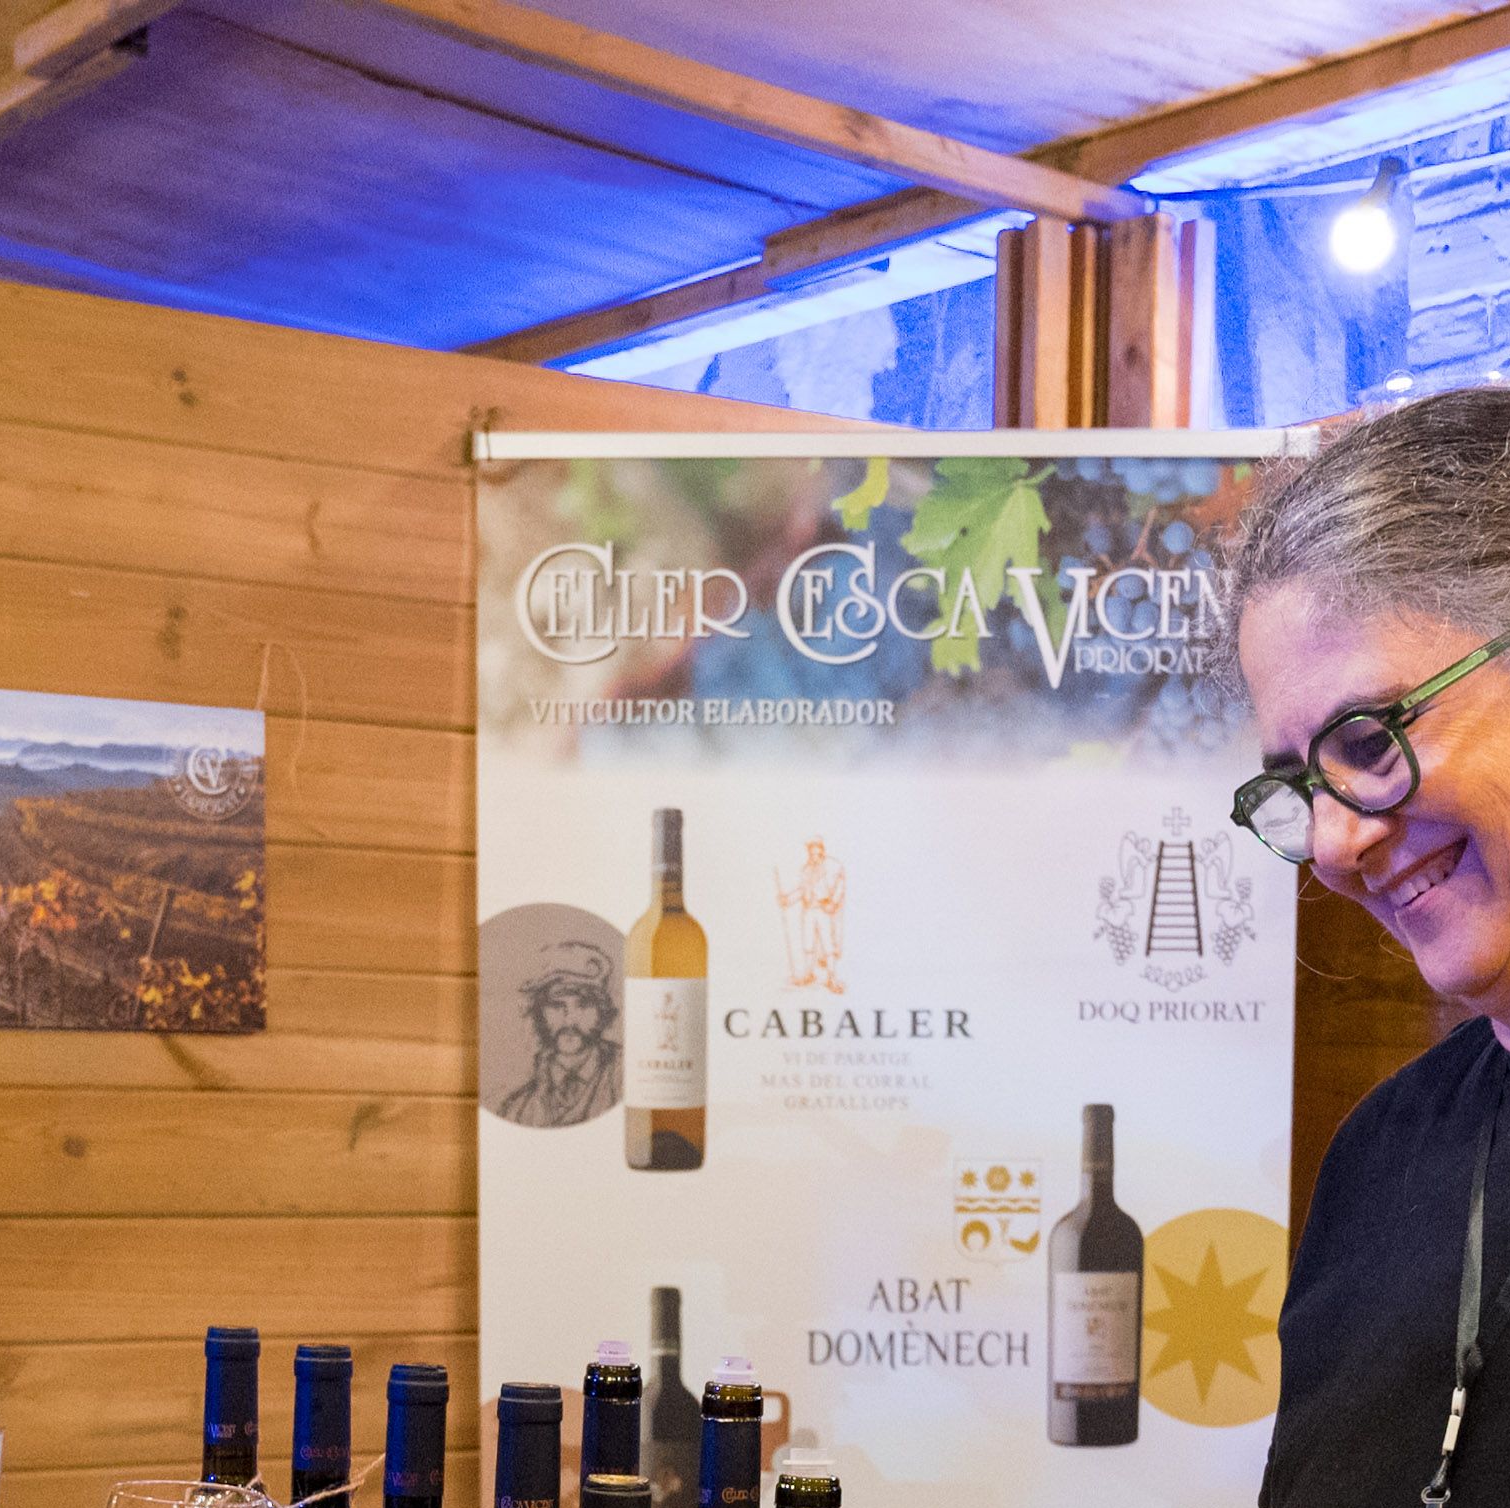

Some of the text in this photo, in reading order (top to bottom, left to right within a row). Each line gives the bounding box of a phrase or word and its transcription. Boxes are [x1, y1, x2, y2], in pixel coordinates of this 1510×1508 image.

[516, 540, 1233, 690] CELLER CESCA VICEN
[530, 699, 895, 726] VITICULTOR ELABORADOR
[723, 1008, 973, 1039] CABALER
[1078, 1000, 1266, 1023] DOQ PRIORAT
[868, 1278, 970, 1314] ABAT
[807, 1320, 1030, 1370] DOMÈNECH
